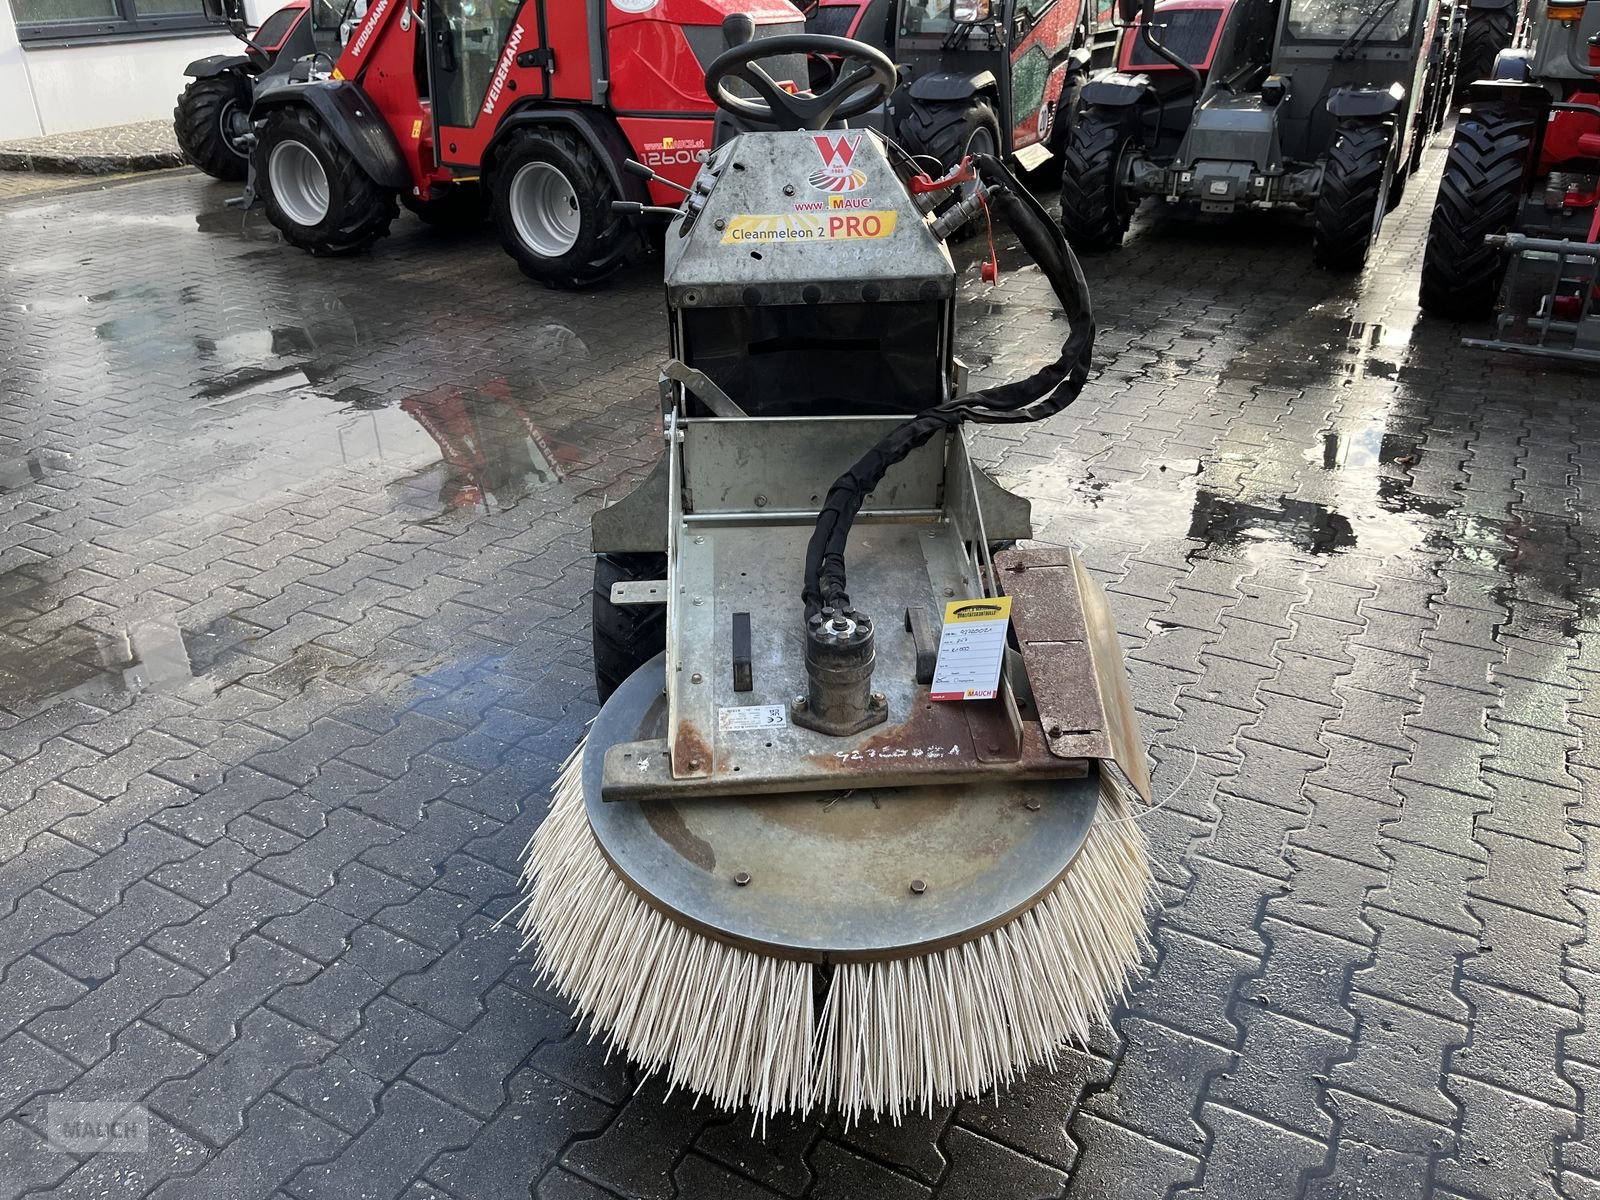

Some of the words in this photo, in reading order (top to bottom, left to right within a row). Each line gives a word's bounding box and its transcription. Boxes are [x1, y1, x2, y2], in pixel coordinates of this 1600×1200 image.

[351, 0, 389, 57] WEIDEMANN
[483, 23, 526, 115] WEIDEMANN
[732, 228, 813, 240] Cleanmeleon
[818, 227, 825, 237] 2
[829, 215, 881, 238] PRO
